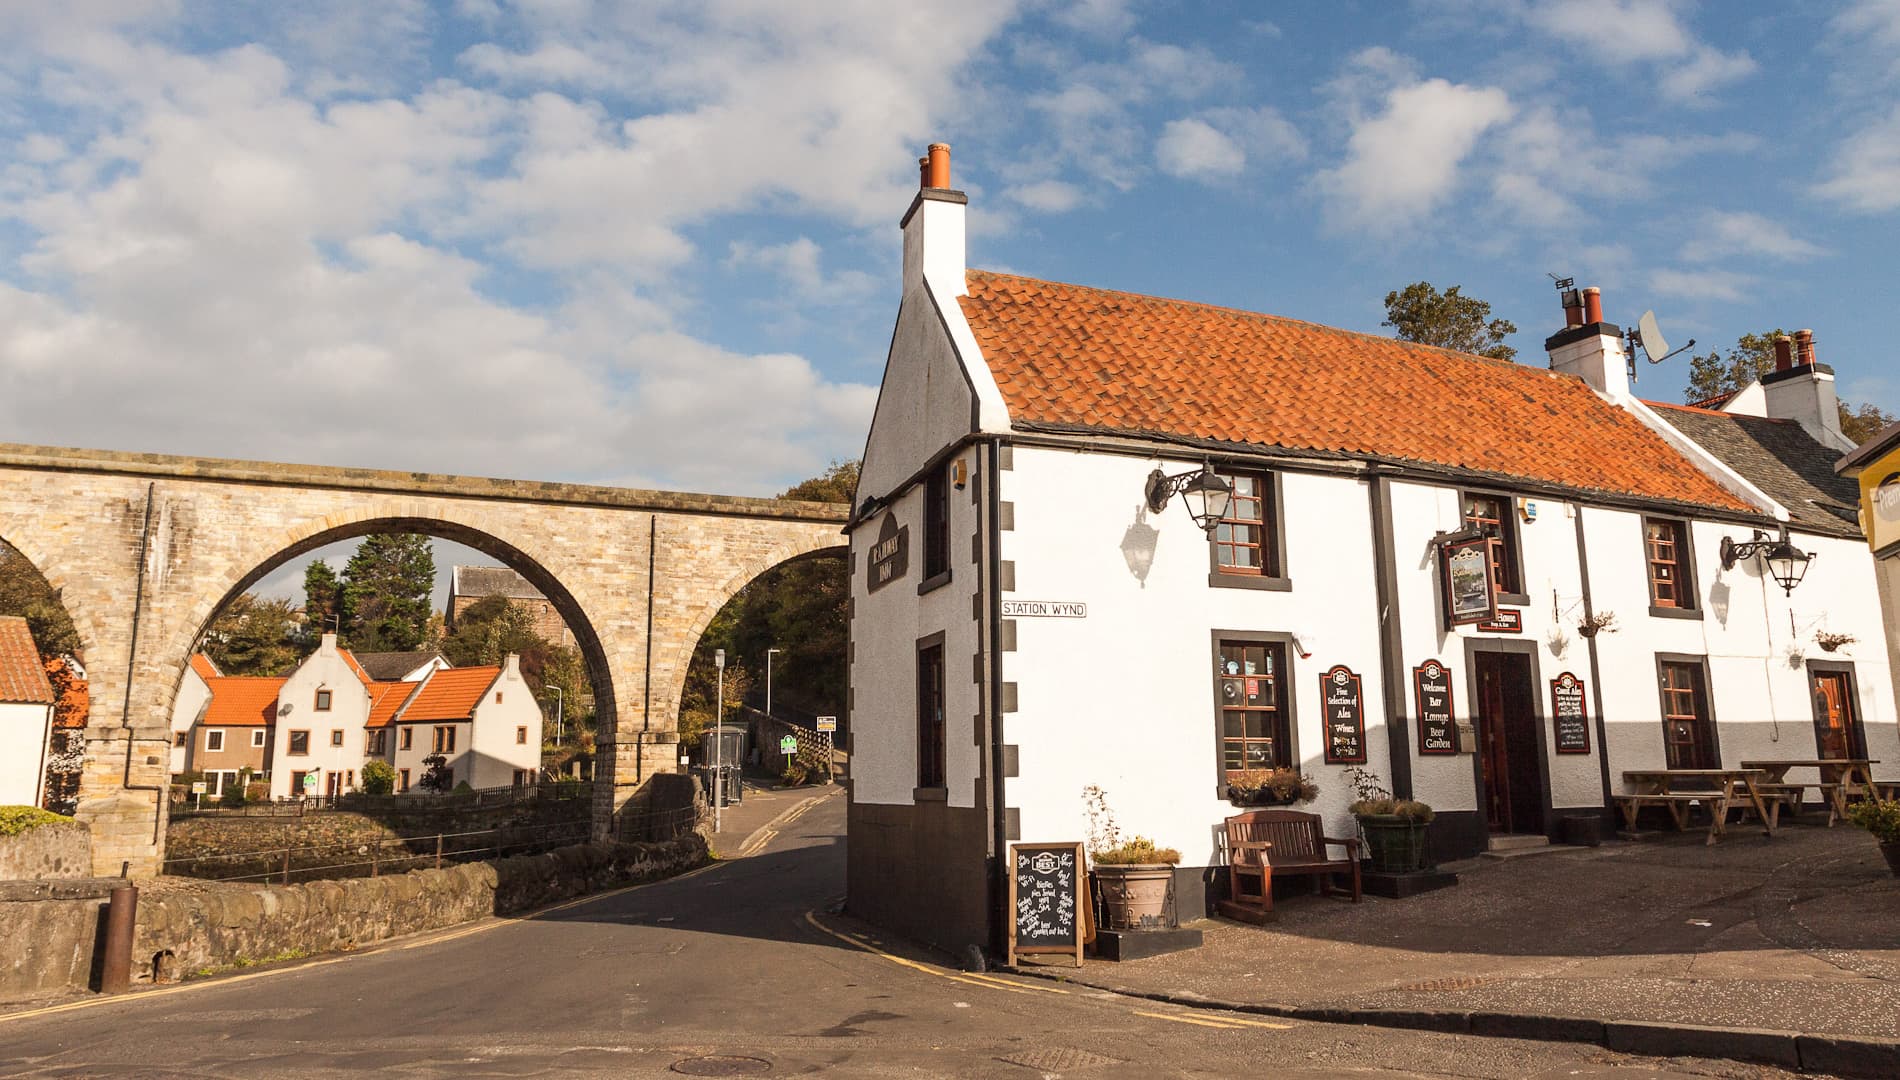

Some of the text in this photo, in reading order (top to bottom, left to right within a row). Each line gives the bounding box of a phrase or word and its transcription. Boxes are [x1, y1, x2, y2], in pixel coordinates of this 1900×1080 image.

[880, 561, 892, 582] INN
[1003, 602, 1084, 616] STATION WYND
[1336, 687, 1348, 696] Fine
[1422, 681, 1446, 693] Welcome
[1327, 695, 1357, 708] Selection of
[1429, 697, 1442, 707] Bar
[1337, 706, 1351, 718] Ales
[1424, 712, 1448, 725] Lounge
[1335, 723, 1355, 733] Wines
[1430, 728, 1445, 737] Beer
[1426, 738, 1451, 749] Garden
[1035, 861, 1056, 869] BEST
